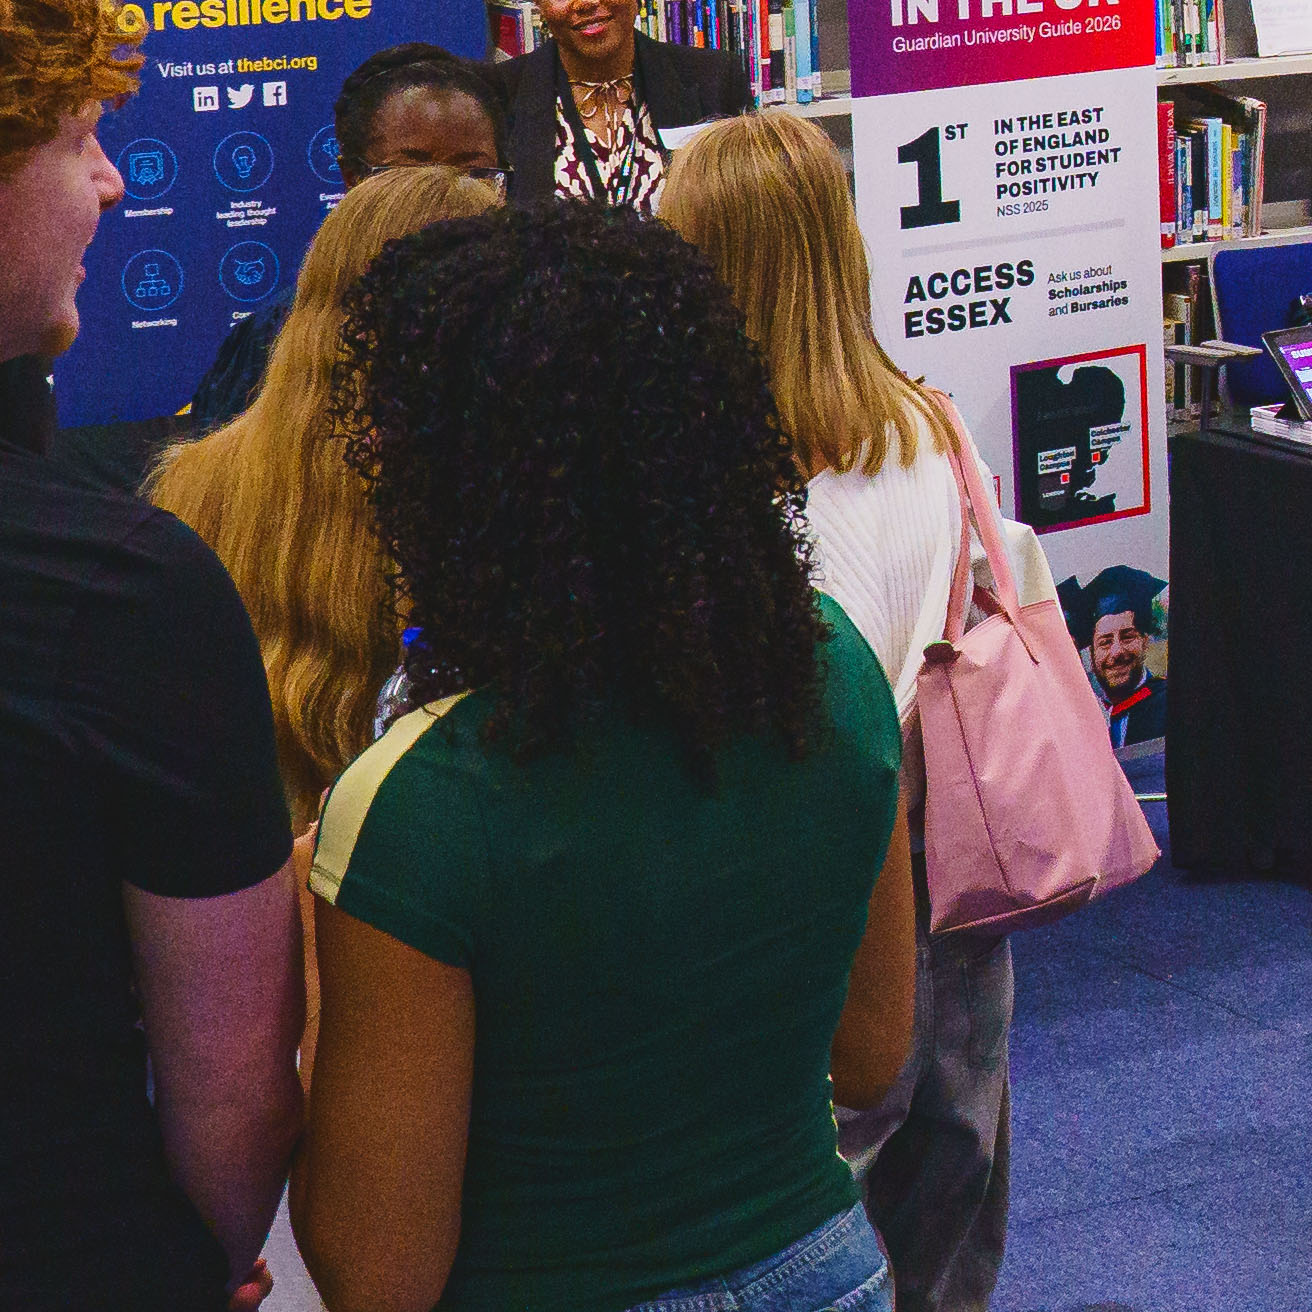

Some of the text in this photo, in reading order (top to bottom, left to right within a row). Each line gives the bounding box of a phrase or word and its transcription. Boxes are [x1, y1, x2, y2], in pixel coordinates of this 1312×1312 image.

[893, 15, 1121, 53] Guardian University Guide 2026
[158, 55, 318, 78] Visit us at thebci.org
[994, 107, 1104, 135] IN THE EAST
[994, 128, 1110, 157] OF ENGLAND
[897, 123, 968, 229] 1 ST
[996, 147, 1121, 178] FOR STUDENT
[996, 171, 1099, 200] POSITIVITY
[997, 199, 1049, 217] NSS 2025
[904, 259, 1035, 304] ACCESS
[1048, 264, 1112, 285] Ask us about
[1048, 279, 1128, 301] Scholarships
[904, 296, 1013, 339] ESSEX
[1048, 294, 1129, 318] and Bursaries
